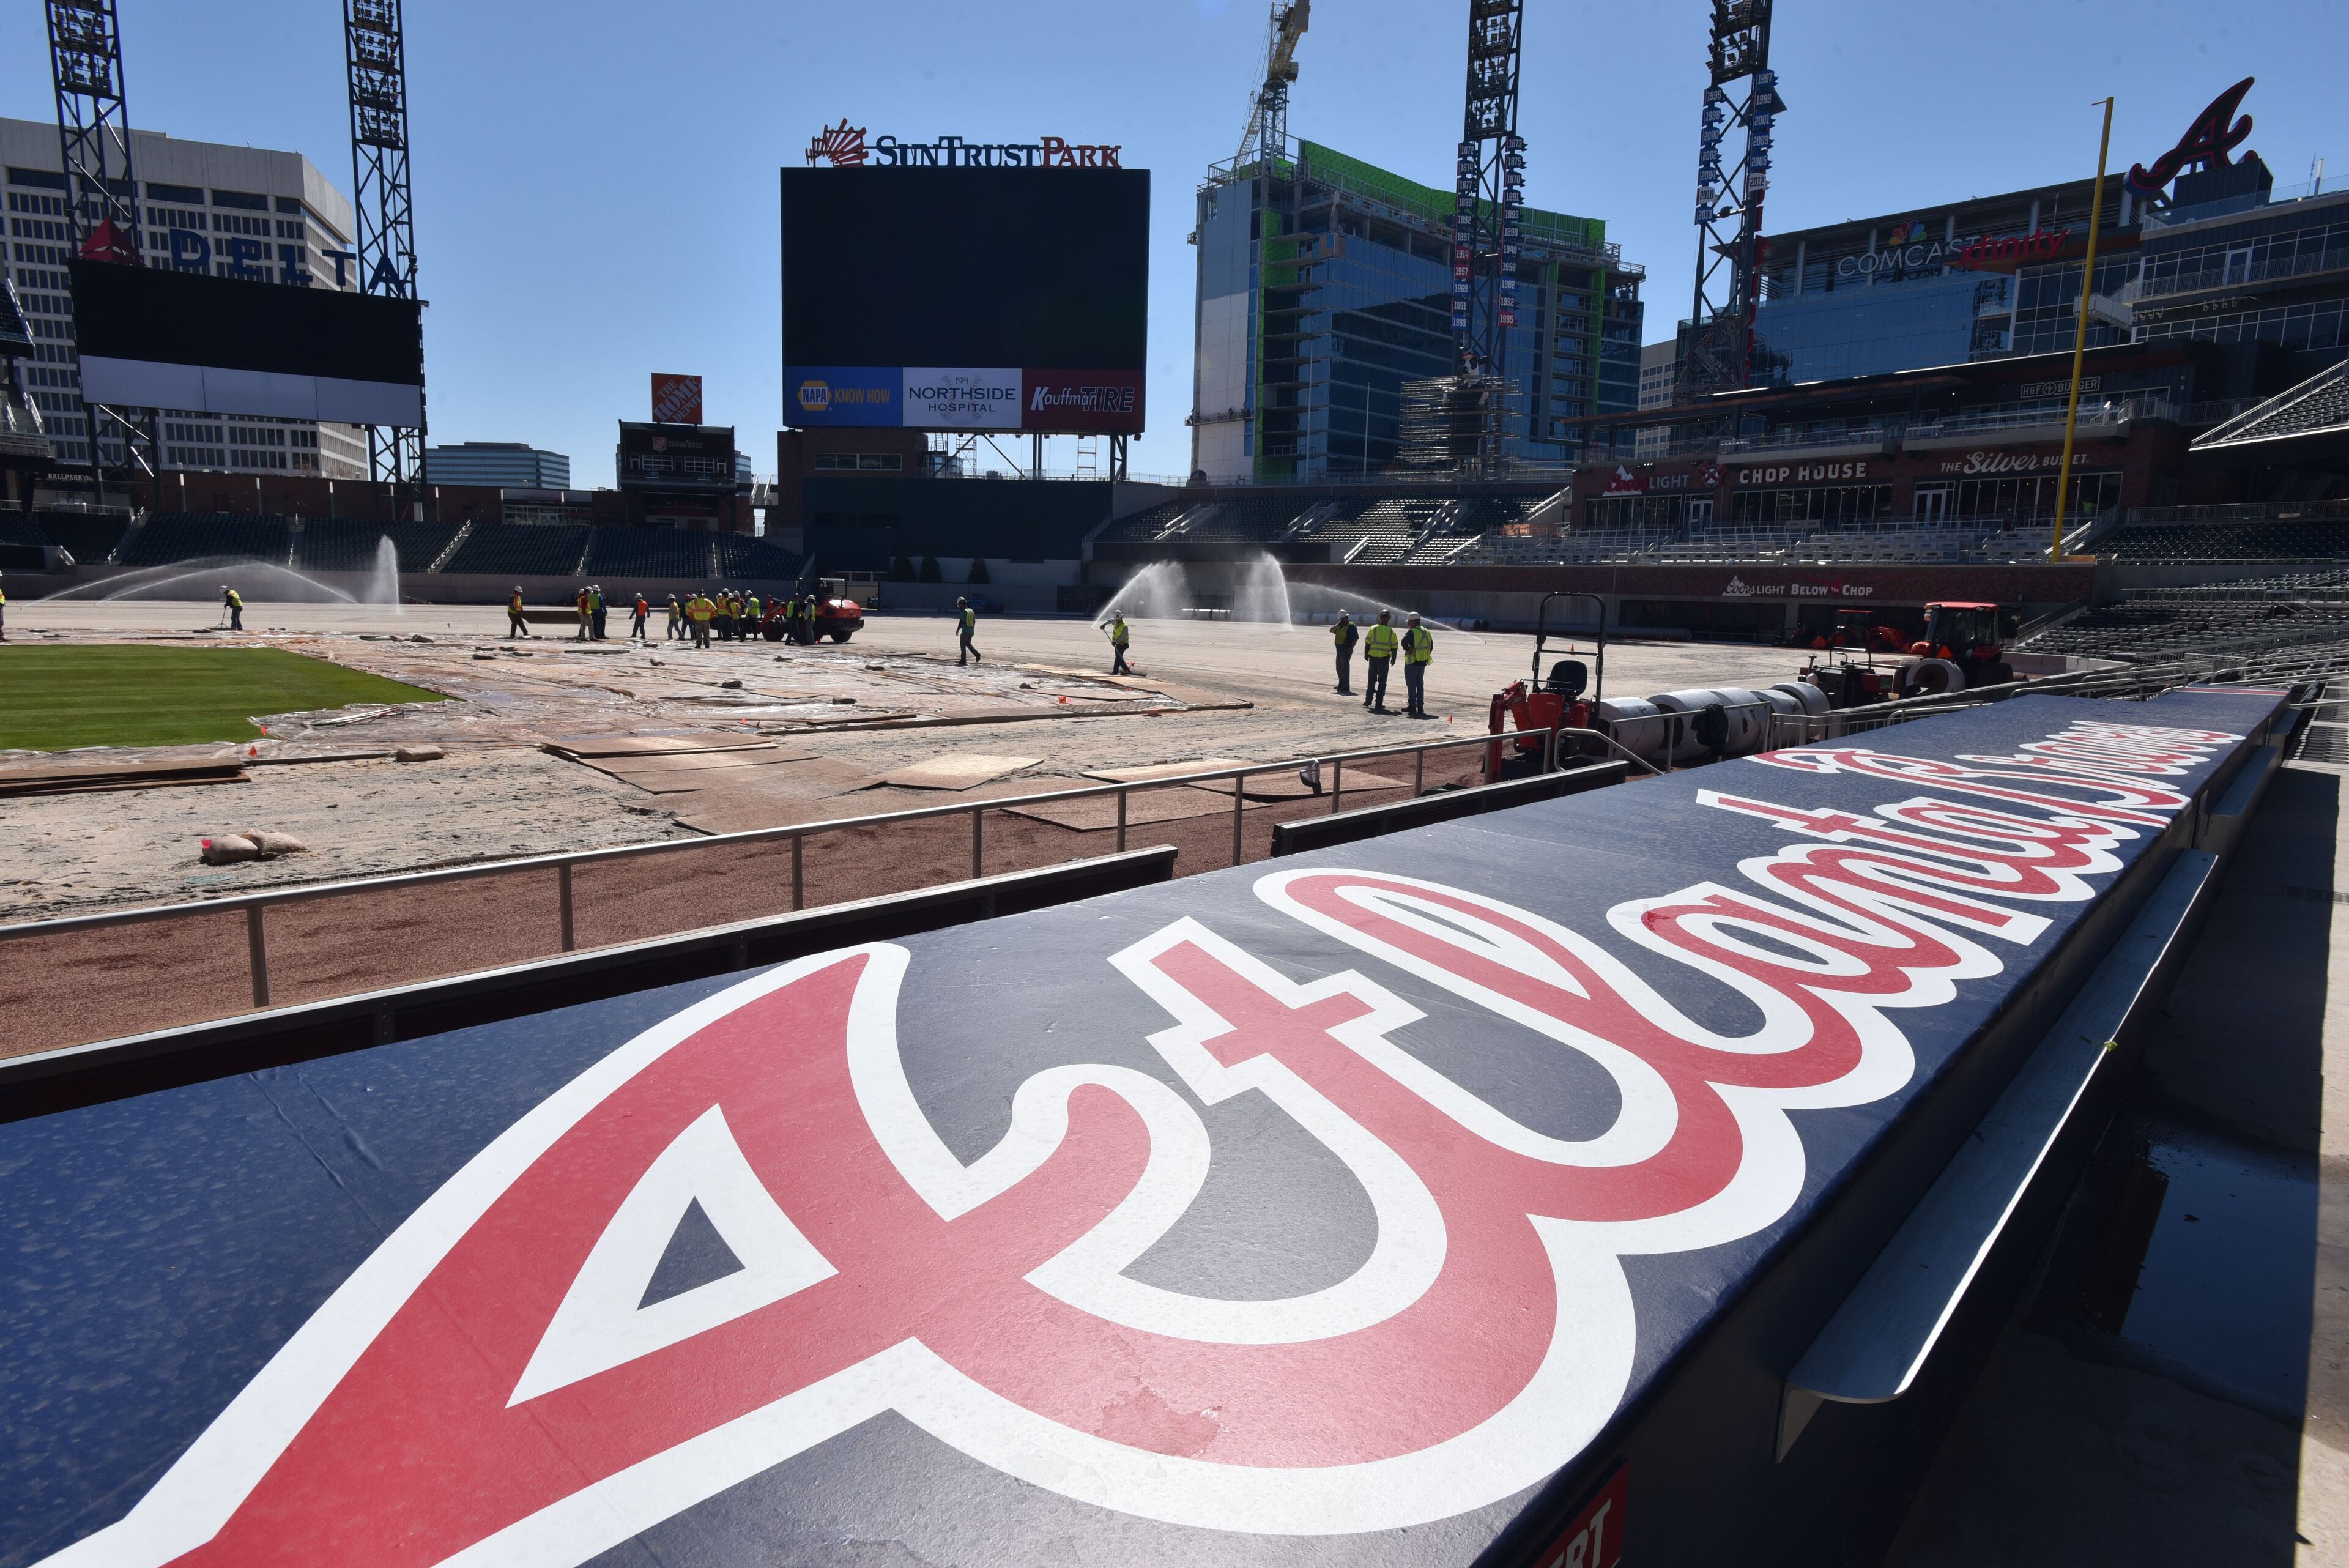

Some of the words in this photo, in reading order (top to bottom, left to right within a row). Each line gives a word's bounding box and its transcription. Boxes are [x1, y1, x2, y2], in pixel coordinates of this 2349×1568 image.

[1757, 73, 1773, 84] 1997
[1707, 89, 1721, 102] 1996
[1756, 94, 1772, 105] 1999
[1705, 110, 1720, 121] 1998
[1754, 114, 1770, 126] 2001
[1704, 130, 1719, 141] 2000
[1753, 135, 1769, 146] 2003
[1509, 139, 1522, 147] 1873
[1461, 146, 1474, 154] 1872
[1702, 150, 1717, 160] 2002
[1508, 157, 1521, 166] 1875
[1751, 155, 1767, 167] 2005
[1460, 163, 1473, 172] 1874
[1507, 174, 1520, 184] 1878
[1701, 170, 1716, 180] 2004
[1460, 180, 1472, 189] 1877
[1750, 177, 1765, 187] 2012
[1506, 192, 1519, 201] 1891
[1700, 190, 1713, 201] 2010
[1458, 198, 1472, 207] 1883
[1458, 215, 1471, 224] 1892
[1505, 210, 1519, 219] 1893
[1698, 210, 1712, 220] 2013
[1457, 232, 1471, 241] 1897
[1504, 228, 1518, 237] 1898
[1504, 245, 1517, 254] 1948
[1958, 226, 2071, 269] xfinity
[1456, 250, 1469, 258] 1914
[169, 228, 406, 297] DELTA
[1502, 262, 1516, 272] 1958
[1455, 267, 1469, 275] 1957
[1455, 284, 1468, 292] 1969
[1501, 280, 1515, 289] 1982
[1454, 301, 1466, 310] 1991
[1501, 297, 1515, 307] 1992
[1453, 318, 1466, 327] 1993
[1499, 314, 1513, 324] 1995
[657, 380, 678, 398] THE
[2022, 385, 2042, 396] H&F
[2057, 379, 2098, 392] BUGER
[654, 376, 701, 422] HOME
[802, 388, 827, 403] NAPA
[834, 388, 864, 403] KNOW
[867, 388, 891, 404] HOW
[909, 387, 1017, 401] NORTHSIDE
[1031, 387, 1097, 411] Kauffman
[1080, 387, 1135, 412] TIRE
[672, 393, 701, 422] DEPOT
[928, 403, 996, 412] HOSPITAL
[1940, 461, 1962, 472] THE
[1963, 451, 2040, 474] Silver
[2042, 454, 2088, 466] BULET
[1739, 467, 1791, 484] CHOP
[1798, 462, 1867, 481] HOUSE
[1649, 474, 1690, 489] LIGHT
[1726, 581, 1757, 595] Coors
[1756, 585, 1786, 595] LIGHT
[1791, 584, 1829, 595] BELOW
[1842, 584, 1874, 596] CHOP
[28, 787, 2141, 1568] Atlanta
[1743, 720, 2246, 829] Braves
